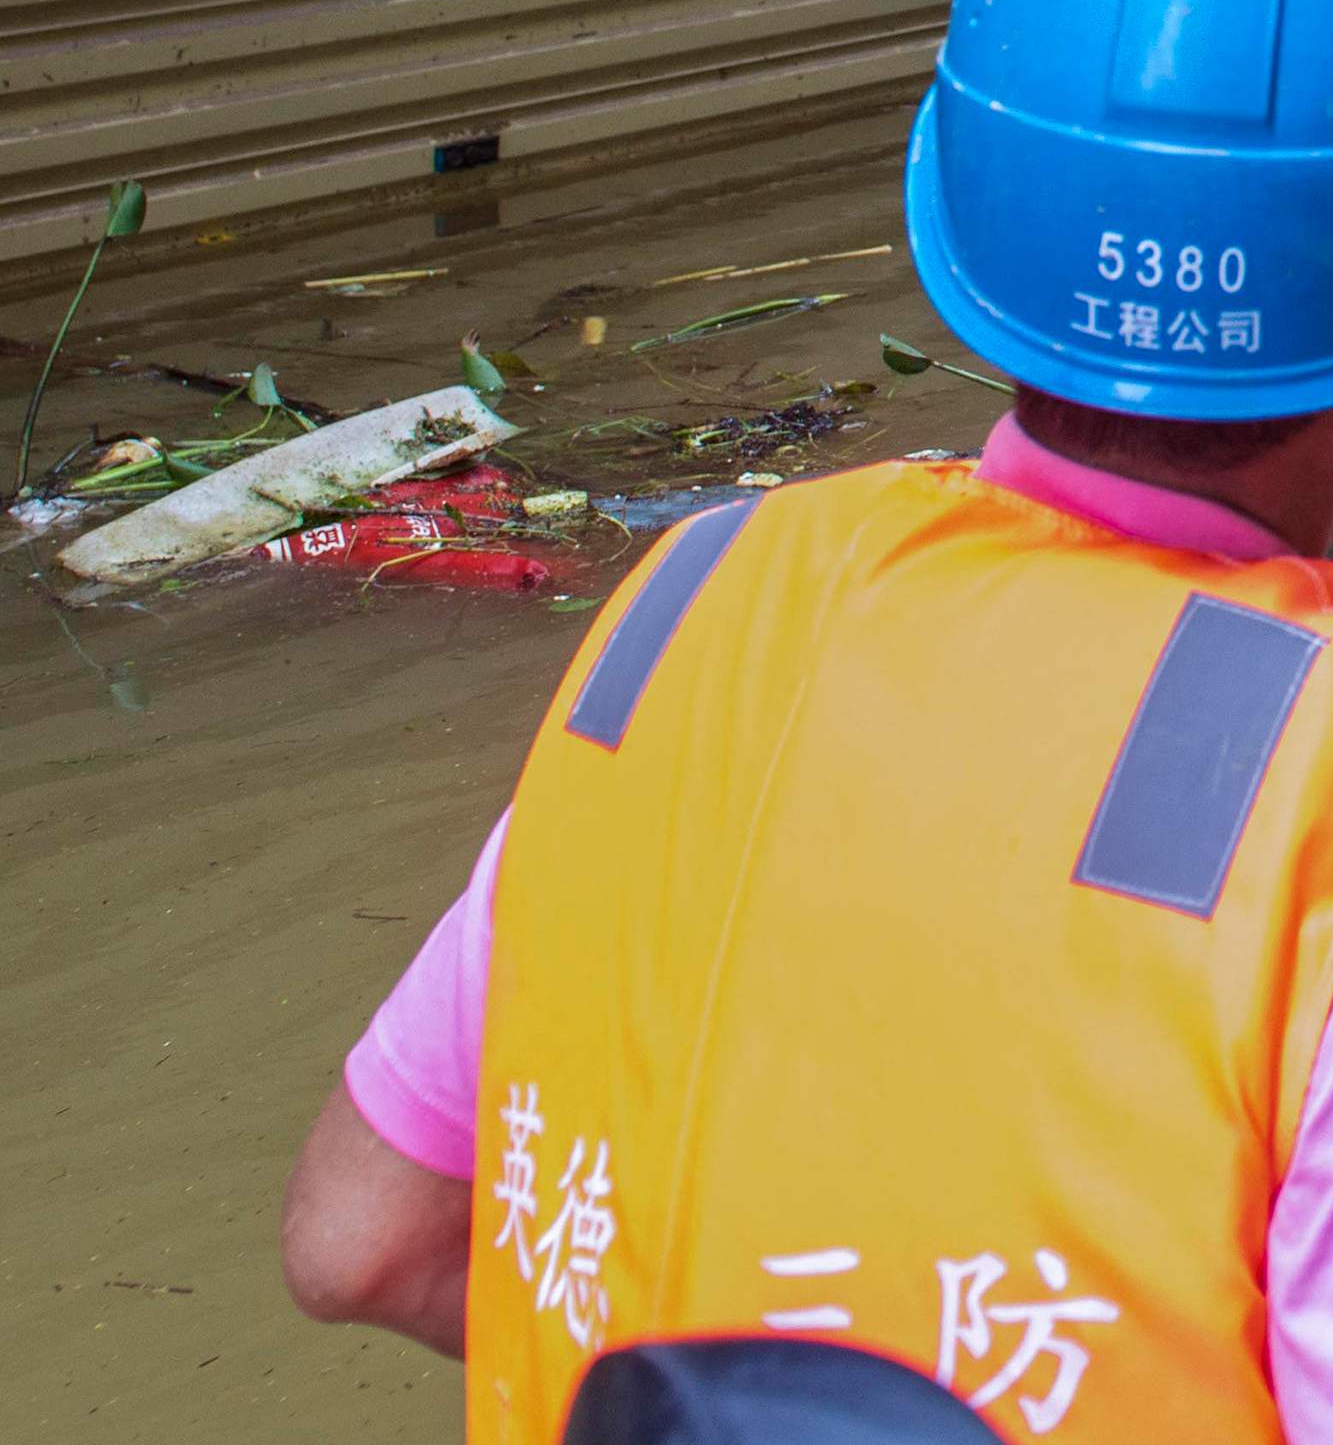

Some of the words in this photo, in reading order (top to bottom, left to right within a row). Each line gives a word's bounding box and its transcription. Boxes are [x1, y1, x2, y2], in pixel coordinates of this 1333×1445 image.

[1097, 230, 1246, 295] 5380
[1070, 291, 1261, 354] 工程公司
